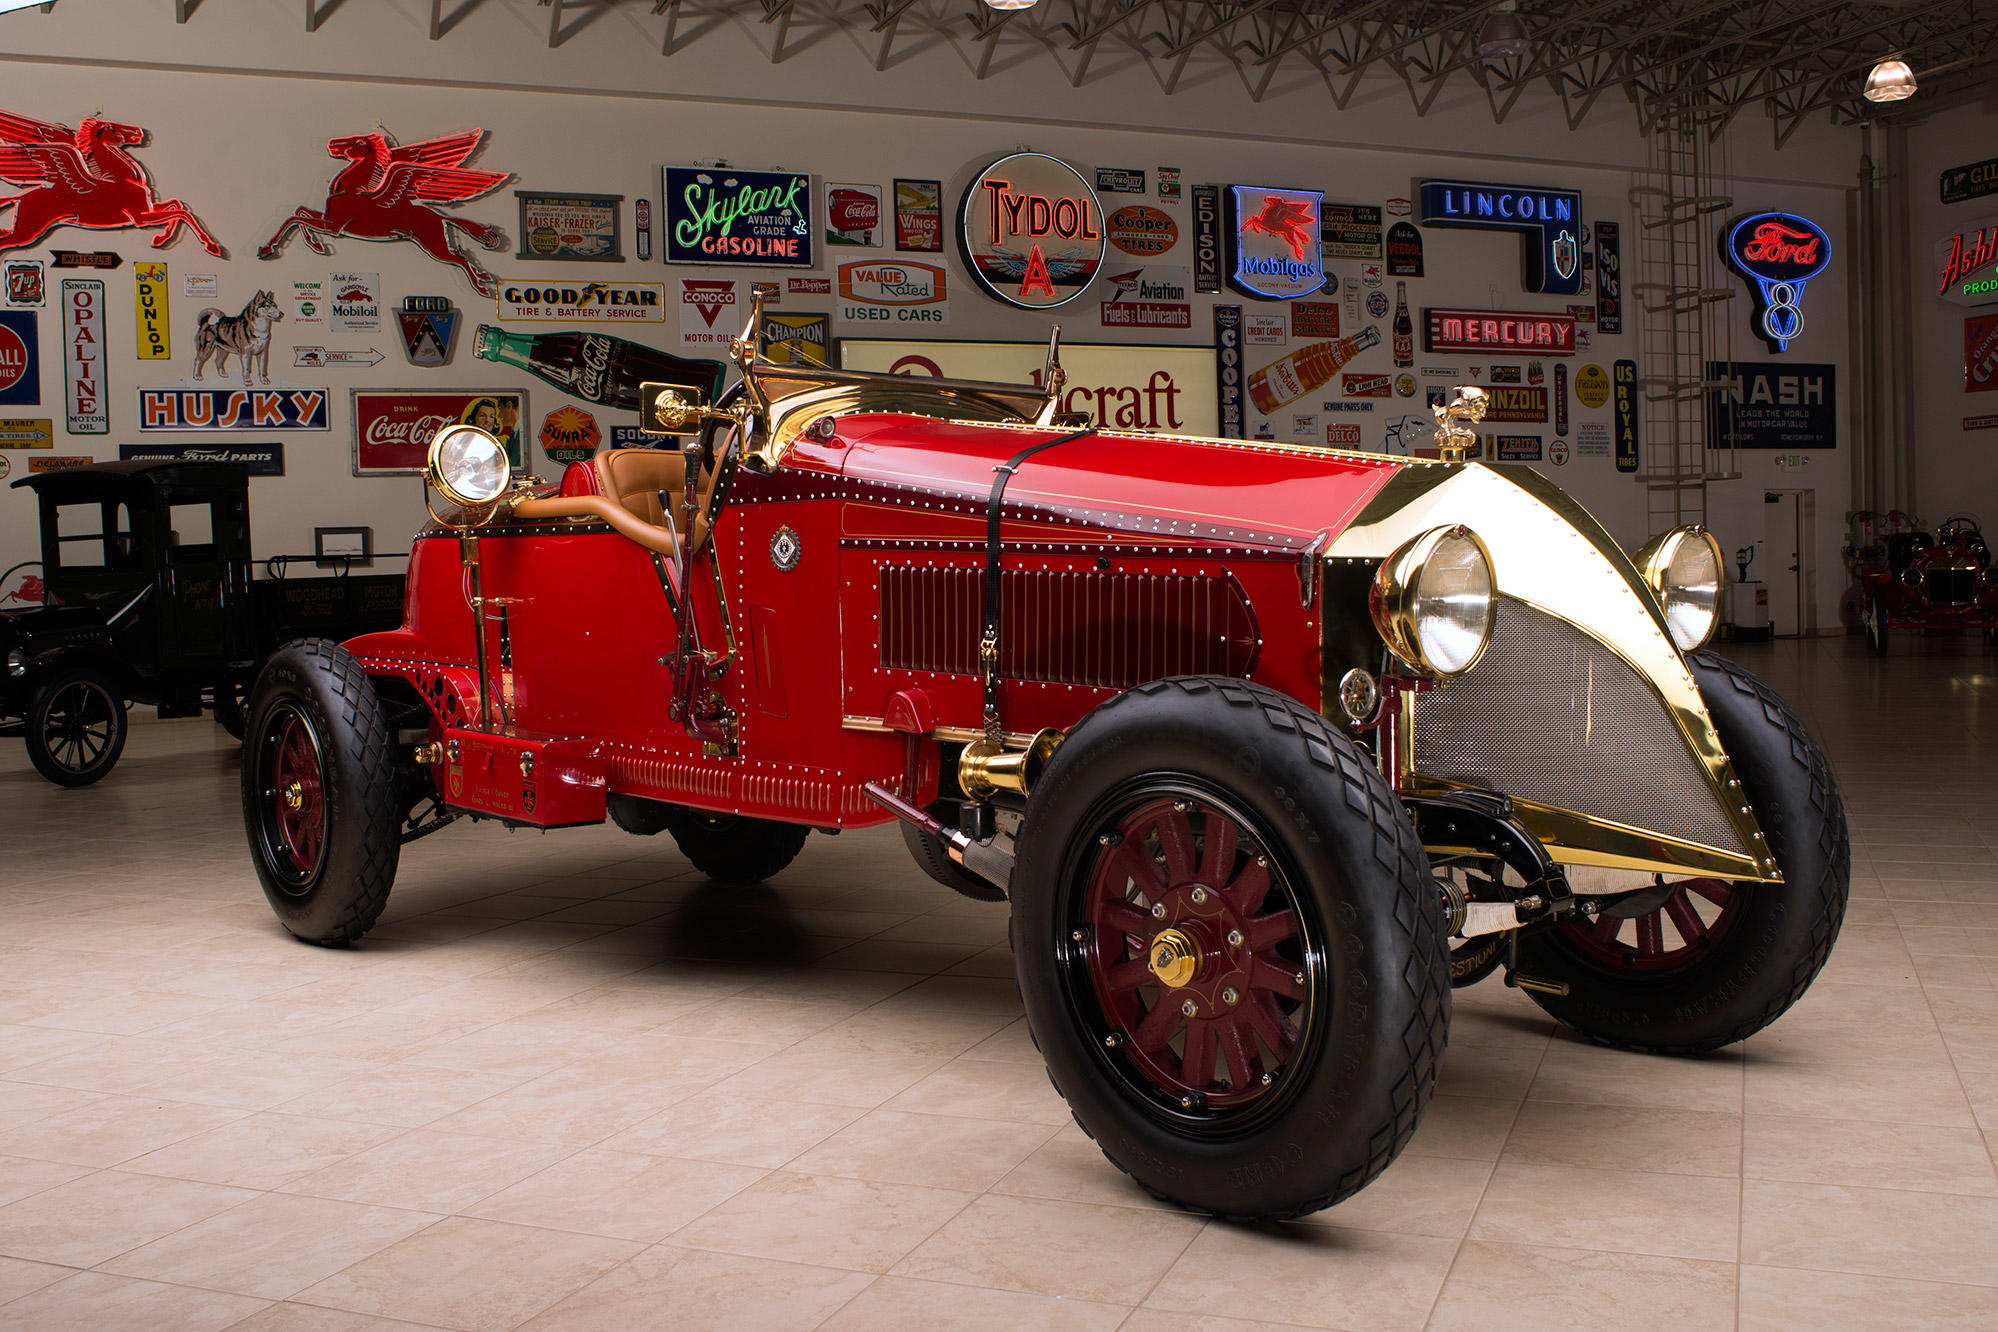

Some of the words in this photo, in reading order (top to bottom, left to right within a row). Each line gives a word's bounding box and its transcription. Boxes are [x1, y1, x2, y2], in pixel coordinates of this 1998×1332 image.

[1103, 177, 1141, 185] CHEVROLET
[675, 176, 804, 248] Skylark
[981, 178, 1099, 245] TYDOL
[1445, 190, 1571, 221] LINCOLN
[527, 216, 595, 231] KAISER-FRAZER
[747, 215, 791, 226] AVIATION
[899, 213, 937, 230] WINGS
[1114, 213, 1172, 232] Cooper
[753, 226, 787, 236] GRADE
[1199, 197, 1216, 274] EDISON
[533, 236, 558, 245] SERVICE
[701, 236, 800, 257] GASOLINE
[1122, 239, 1164, 251] TIRES
[1744, 222, 1820, 264] Ford
[1388, 241, 1422, 256] VEEDOL
[64, 255, 109, 264] WHISTLE
[1019, 243, 1056, 296] A
[1243, 256, 1316, 282] Mobilgas
[333, 273, 347, 282] Ask
[854, 269, 904, 283] VALUE
[294, 282, 322, 290] WELCOME
[1139, 279, 1185, 300] Aviation
[404, 298, 448, 311] FORD
[684, 292, 735, 304] CONOCO
[332, 303, 378, 318] Mobiloil
[516, 307, 540, 316] TIRE
[545, 307, 552, 316] &
[557, 308, 601, 317] BATTERY
[606, 309, 647, 318] SERVICE
[844, 307, 891, 321] USED
[897, 308, 943, 322] CARS
[1104, 303, 1130, 323] Fuels
[1136, 304, 1188, 325] Lubricants
[1297, 303, 1333, 315] Delco
[139, 284, 165, 356] DUNLOP
[1255, 318, 1274, 327] Sinclair
[1294, 314, 1337, 325] BATTERY
[766, 322, 825, 344] CHAMPION
[1247, 326, 1266, 336] CREDIT
[1266, 327, 1283, 337] CARDS
[1295, 325, 1335, 334] SERVICE
[1442, 318, 1570, 345] MERCURY
[684, 333, 714, 343] MOTOR
[717, 334, 737, 343] OILS
[73, 291, 97, 414] OPALINE
[325, 353, 348, 361] SERVICE
[1221, 328, 1240, 439] COOPER
[1358, 382, 1372, 391] LION
[1372, 377, 1390, 387] HEAD
[1719, 374, 1824, 406] NASH
[144, 390, 324, 428] HUSKY
[394, 405, 419, 413] DRINK
[1323, 401, 1344, 412] GENUINE
[1344, 402, 1359, 411] PARTS
[1360, 402, 1373, 411] ONLY
[69, 415, 106, 423] MOTOR
[1617, 385, 1636, 455] ROYAL
[1736, 409, 1763, 418] LEADS
[1765, 409, 1781, 418] THE
[1784, 409, 1810, 418] WORLD
[79, 423, 96, 431] OIL
[1746, 419, 1770, 428] MOTOR
[1770, 420, 1786, 429] CAR
[1787, 420, 1808, 429] VALUE
[543, 423, 597, 443] SUNRAY
[1328, 430, 1359, 442] DELCO
[1500, 437, 1540, 453] ZENITH
[230, 453, 272, 461] PARTS
[556, 450, 585, 460] OILS
[1788, 456, 1801, 467] EXIT
[1618, 457, 1637, 467] TIRES
